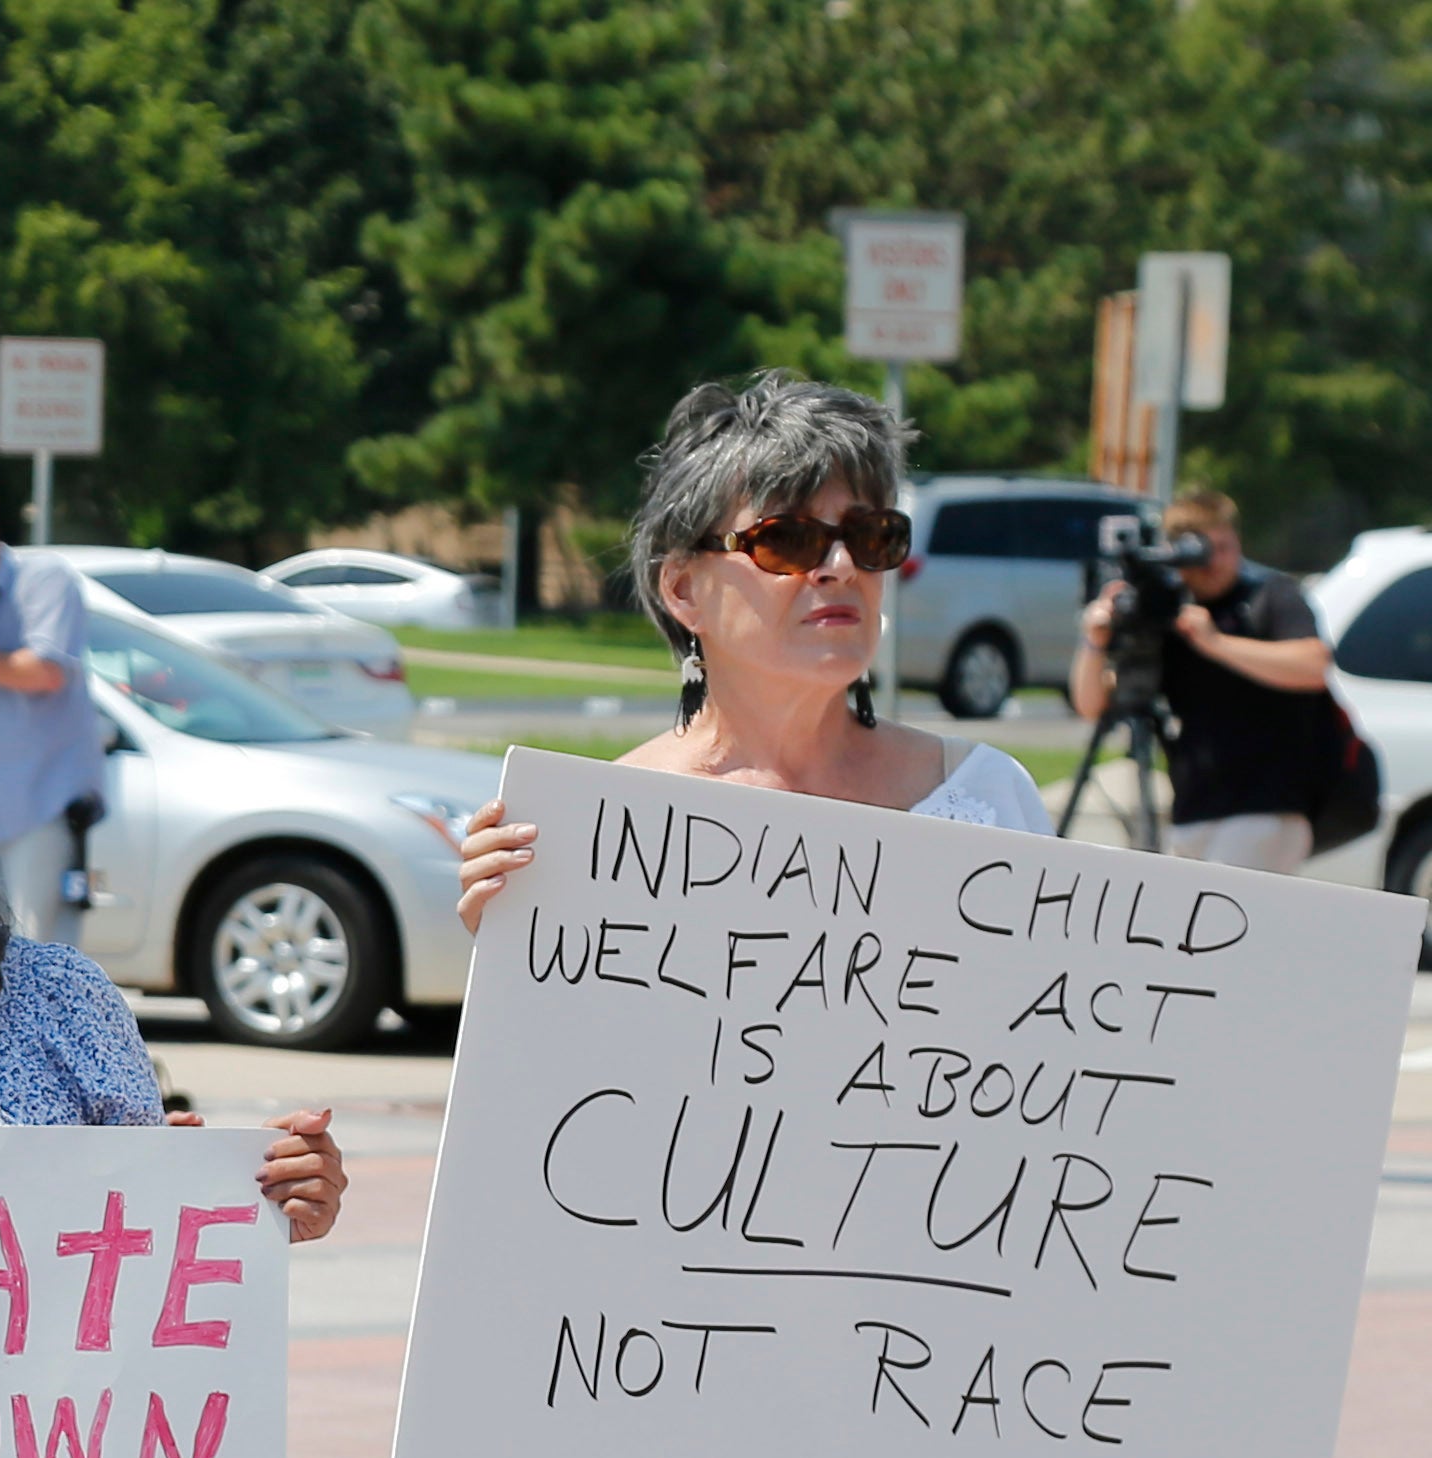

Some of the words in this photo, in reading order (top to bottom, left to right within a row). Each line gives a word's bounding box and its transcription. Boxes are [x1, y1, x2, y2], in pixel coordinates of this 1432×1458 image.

[591, 799, 881, 915] INDIAN
[959, 862, 1247, 955] CHILD
[529, 907, 958, 1026] WELFARE
[1009, 972, 1216, 1041] ACT
[712, 1018, 782, 1084] IS
[837, 1041, 1175, 1135] ABOUT
[544, 1089, 1213, 1290] CULTURE
[548, 1313, 776, 1407] NOT
[855, 1322, 1171, 1444] RACE
